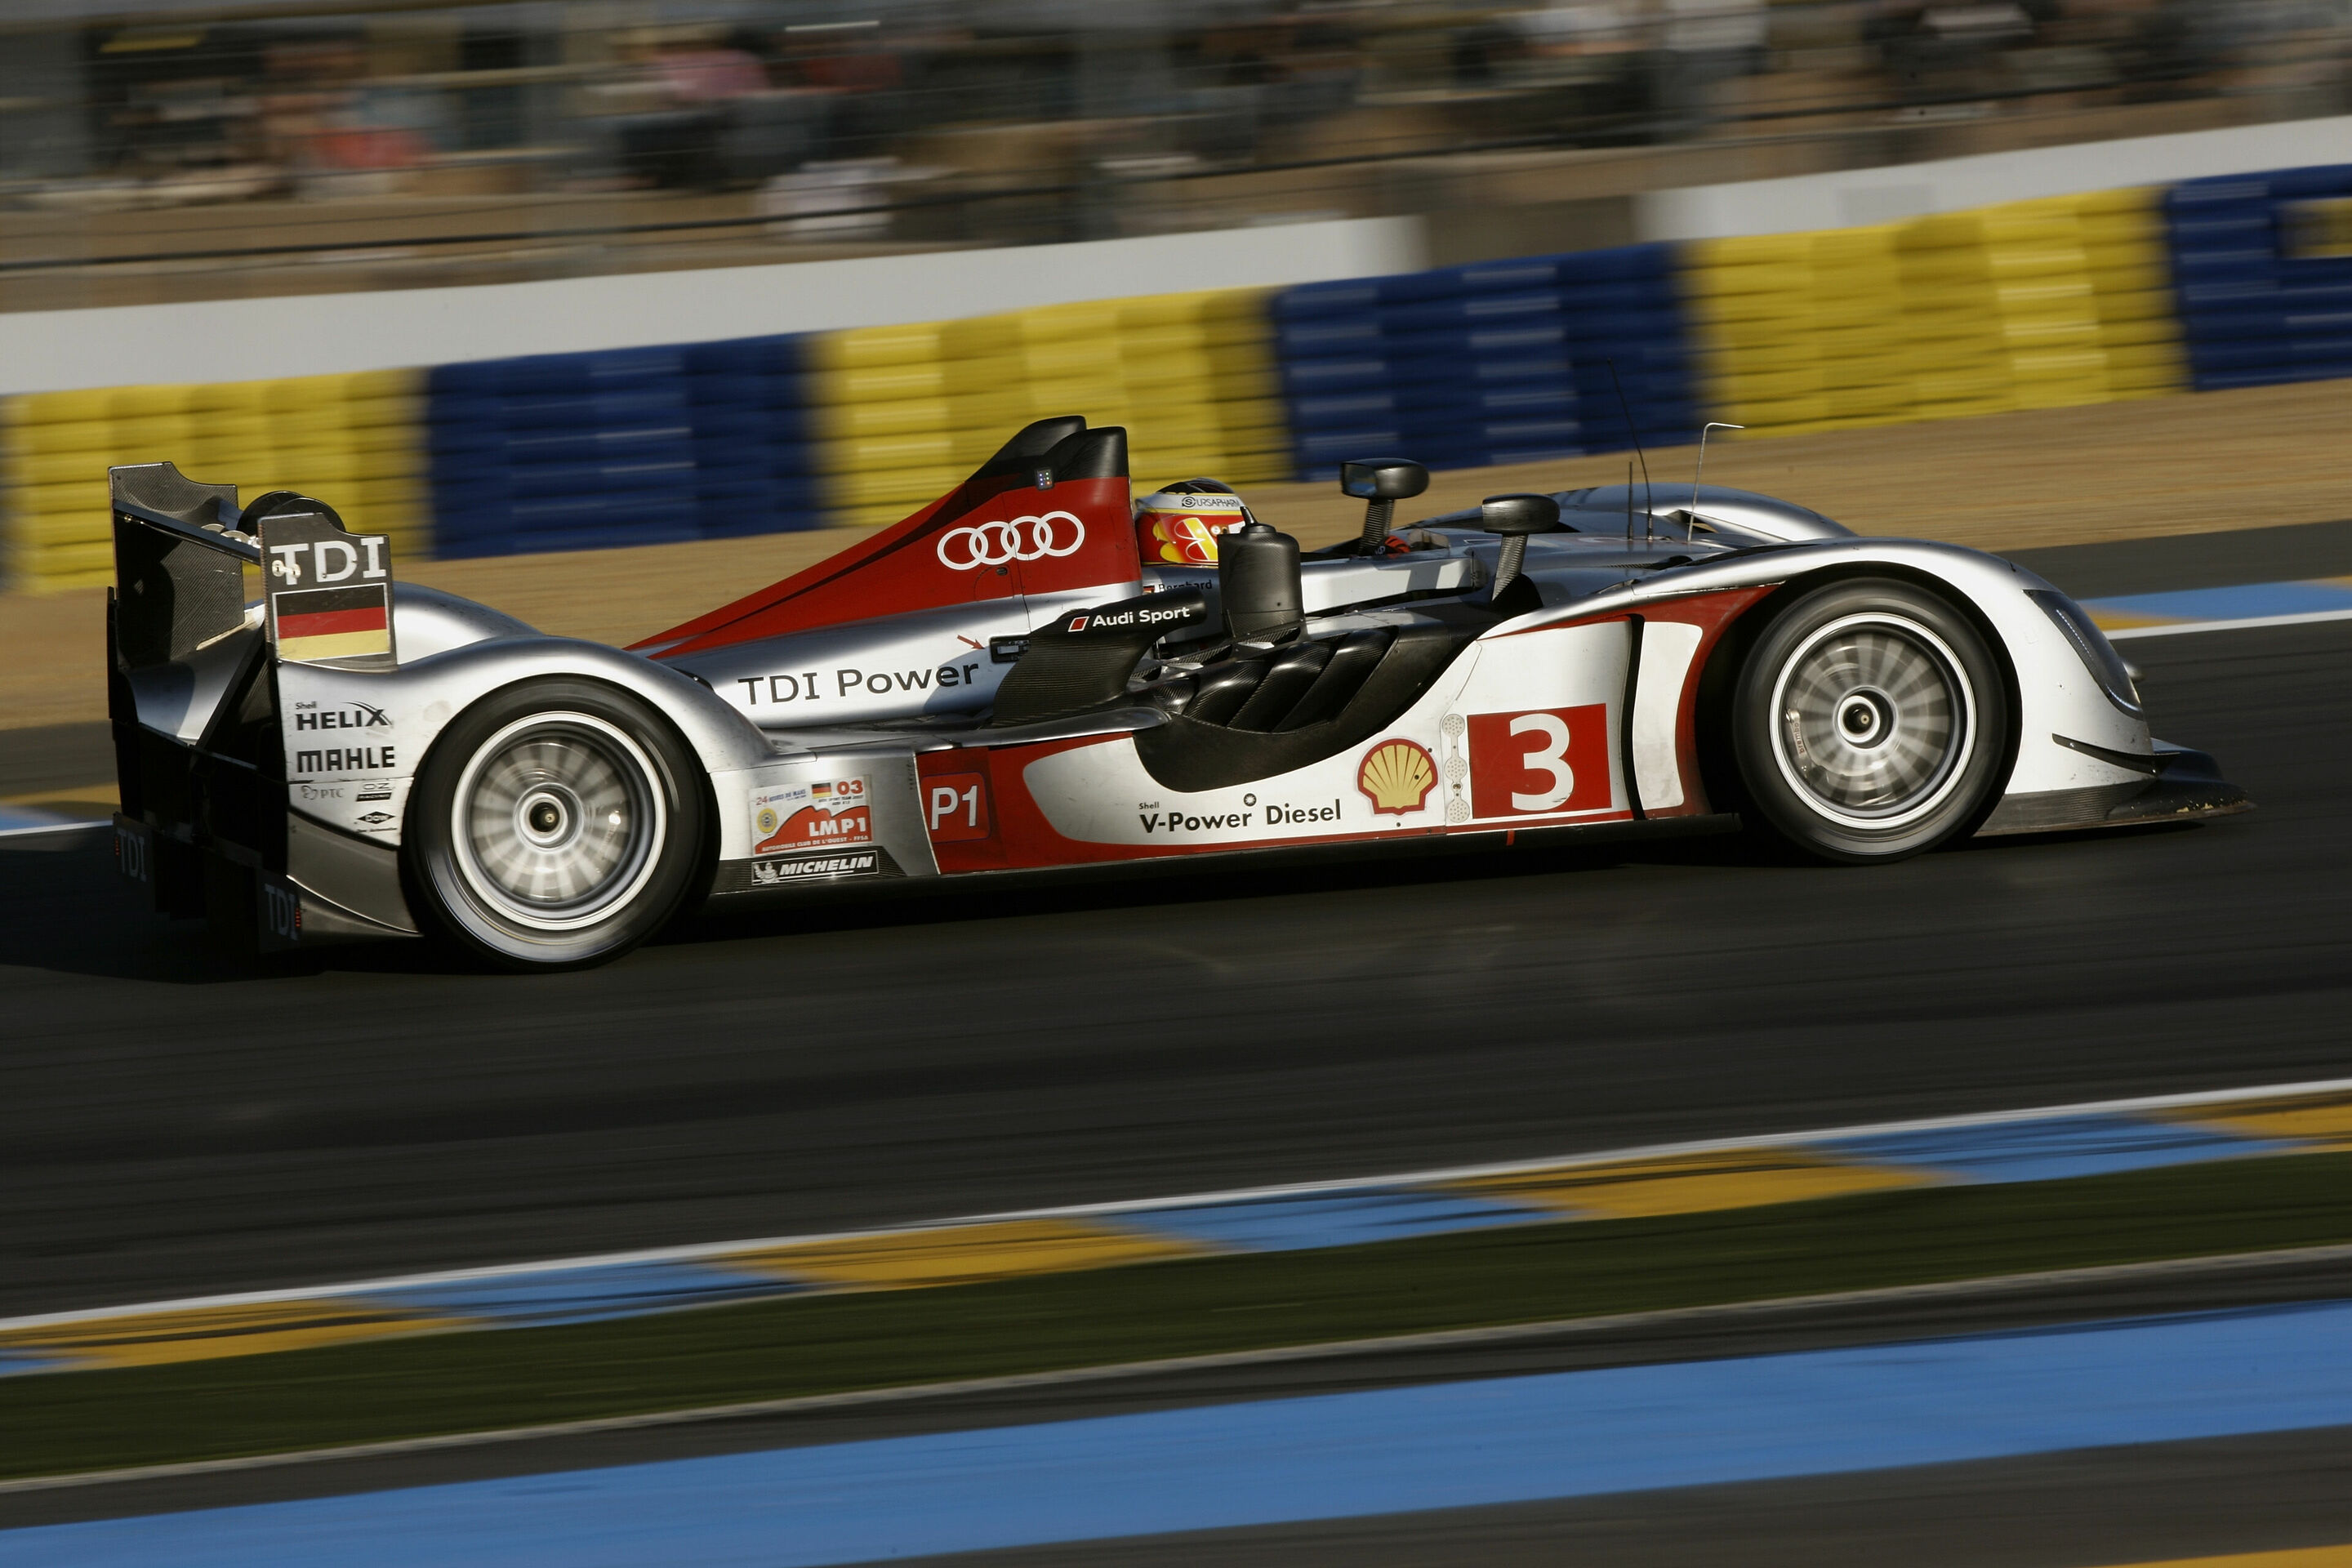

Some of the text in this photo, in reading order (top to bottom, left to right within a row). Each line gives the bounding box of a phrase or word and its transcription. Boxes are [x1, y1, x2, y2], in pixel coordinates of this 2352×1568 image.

[270, 537, 386, 585] TDI
[1092, 607, 1191, 627] Audi Sport
[737, 663, 978, 705] TDI Power
[296, 701, 317, 710] Shell
[296, 708, 390, 731] HELIX
[296, 746, 395, 773] MAHLE
[1509, 713, 1575, 811] 3
[837, 780, 863, 795] 03
[931, 785, 978, 830] P1
[1139, 801, 1160, 809] Shell
[1140, 799, 1341, 833] V-Power Diesel
[779, 856, 874, 875] MICHELIN
[265, 883, 299, 941] TDI
